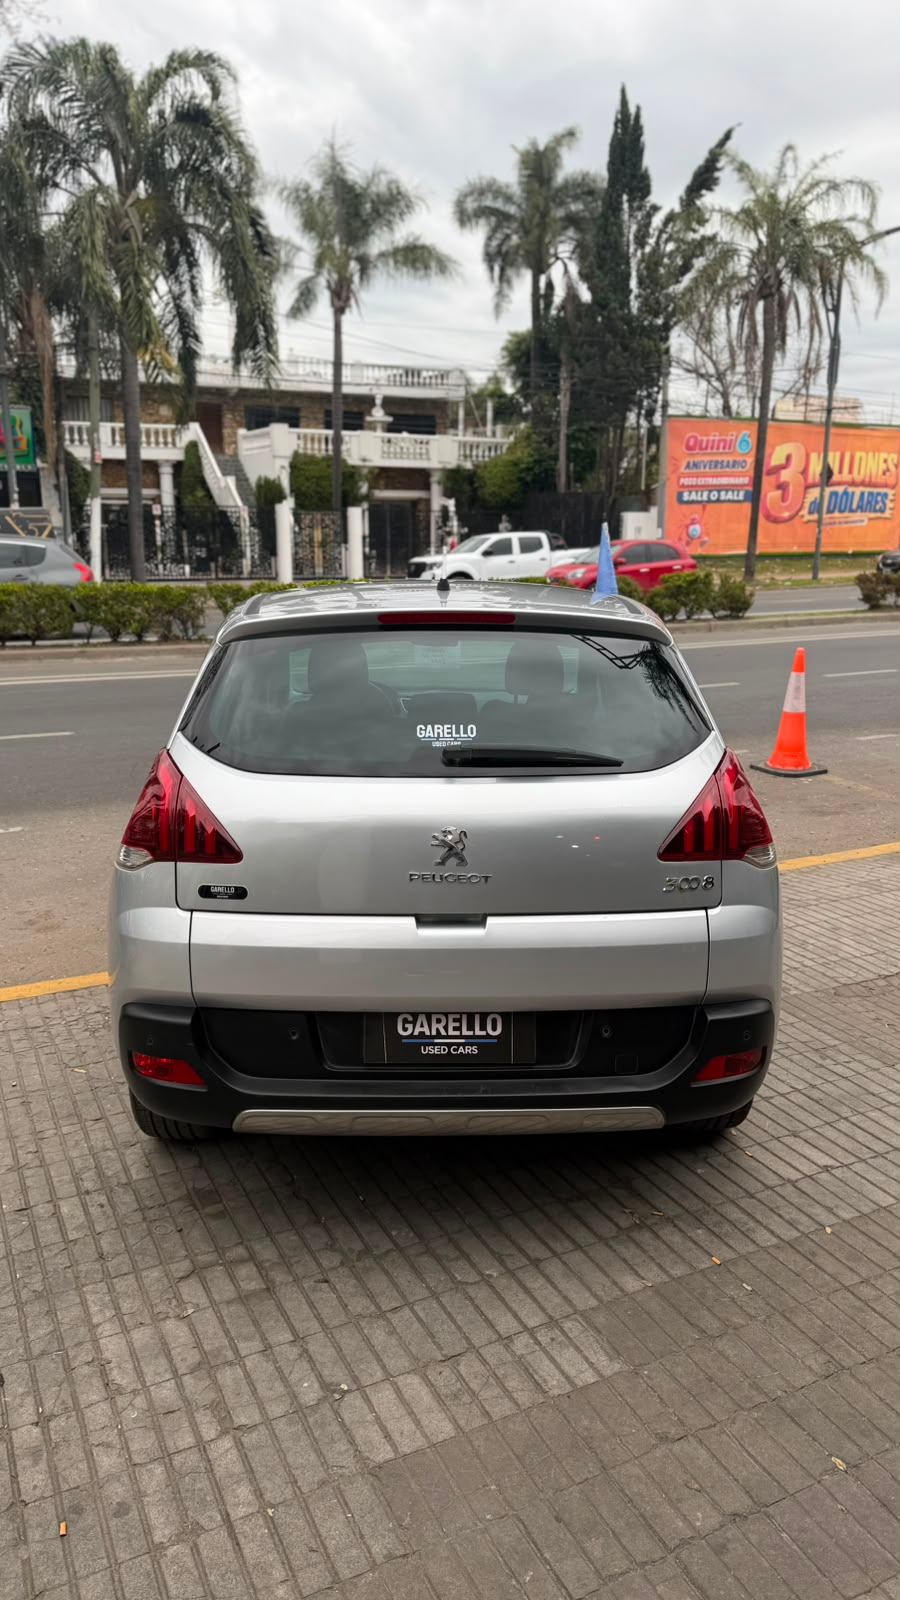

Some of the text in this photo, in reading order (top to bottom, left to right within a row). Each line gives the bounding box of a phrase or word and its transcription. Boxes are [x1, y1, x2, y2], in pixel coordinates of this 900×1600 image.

[683, 431, 752, 454] Quini 6
[684, 459, 748, 470] ANIVERSARIO
[762, 442, 806, 522] 3
[682, 489, 745, 501] SALE O SALE
[826, 485, 888, 514] DÓLARES
[416, 724, 477, 738] GARELLO
[408, 871, 493, 884] PEUGEOT
[662, 874, 715, 892] 3008
[210, 886, 235, 894] GARELLO
[396, 1013, 503, 1037] GARELLO
[421, 1045, 479, 1055] USED CARS
